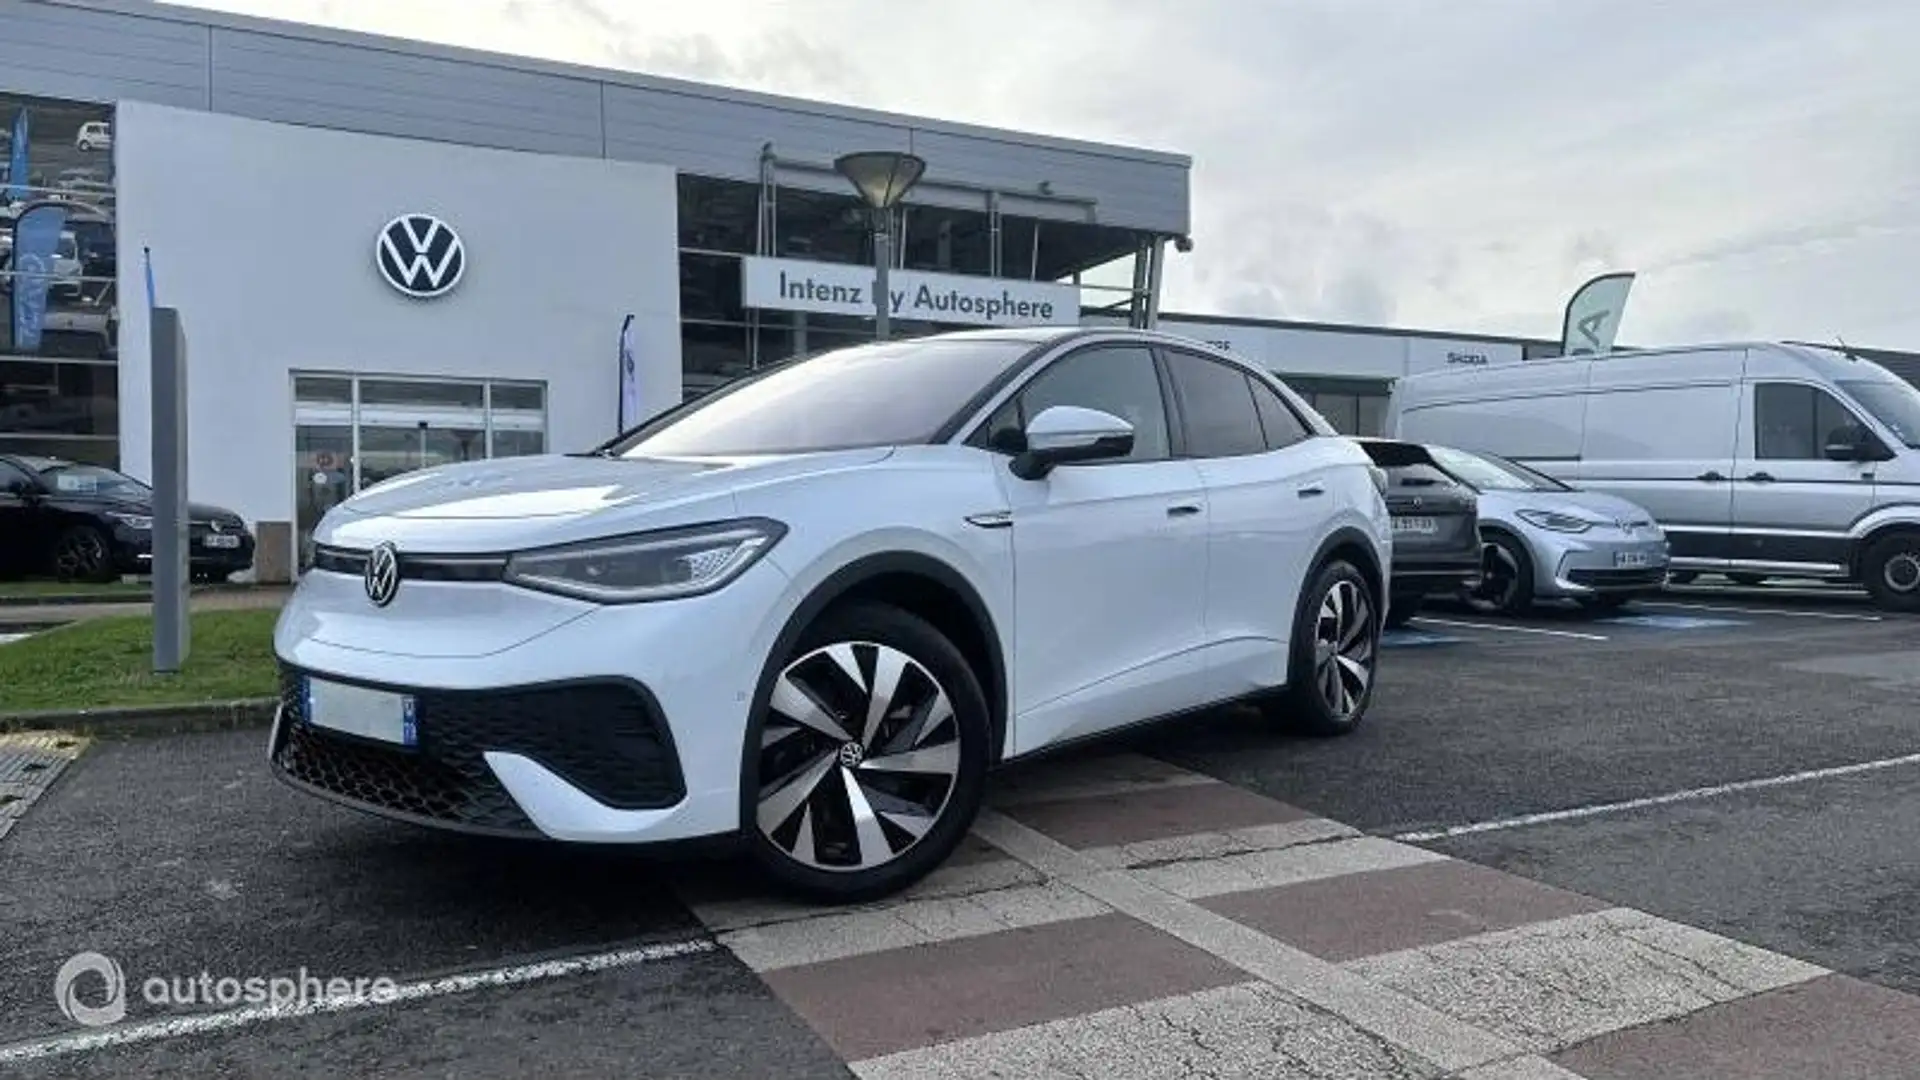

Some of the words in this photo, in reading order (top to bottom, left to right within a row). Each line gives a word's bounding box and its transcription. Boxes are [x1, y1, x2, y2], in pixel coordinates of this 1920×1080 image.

[379, 214, 463, 293] VW
[779, 271, 863, 305] Intenz
[872, 280, 905, 314] y
[914, 285, 1054, 320] Autosphere
